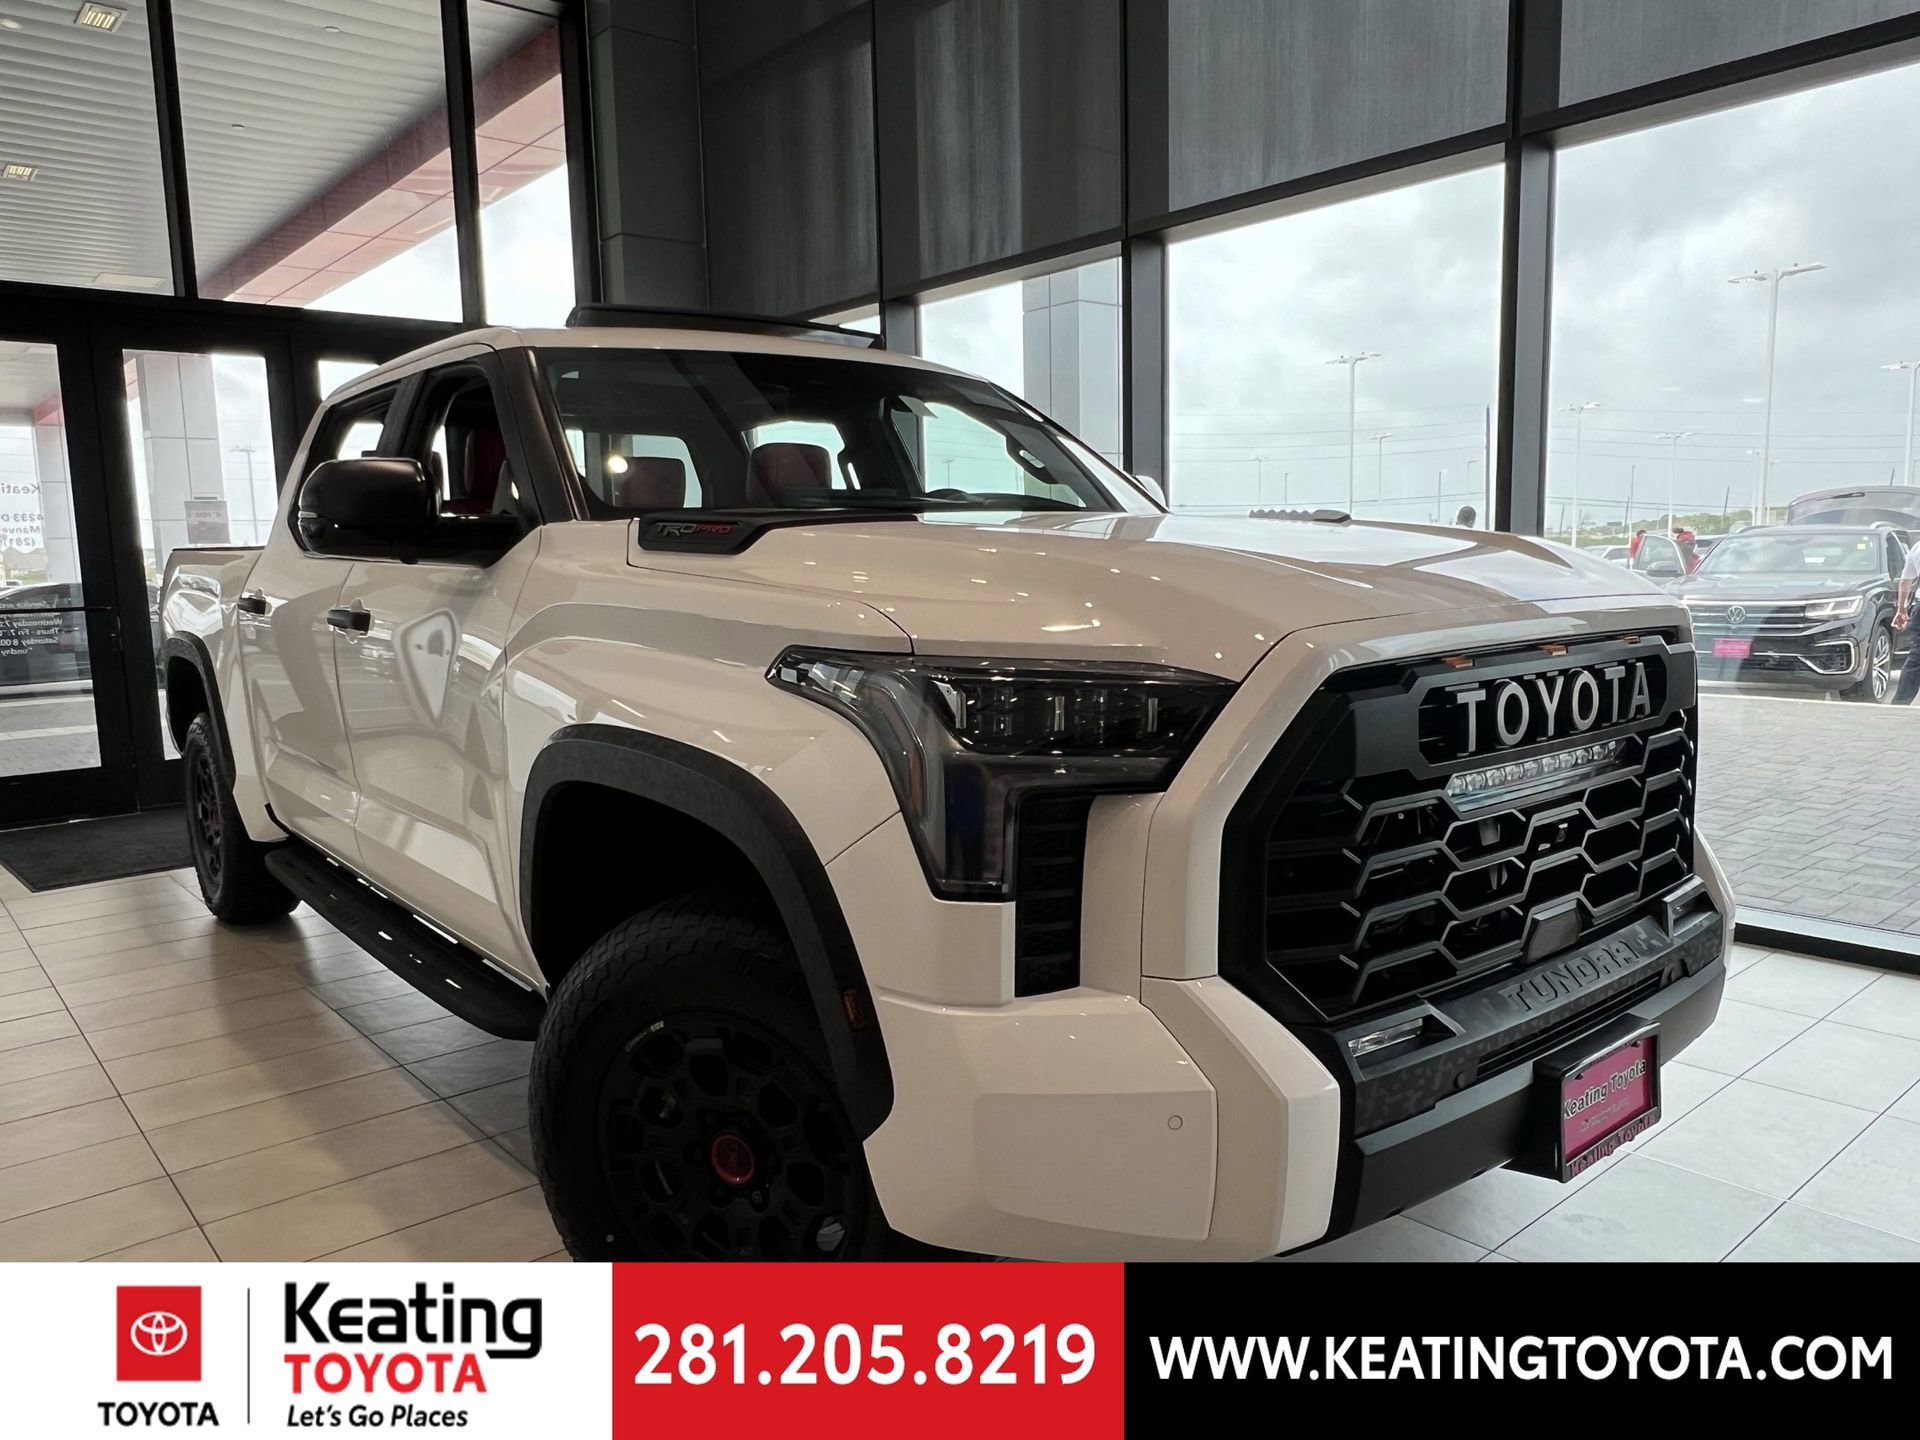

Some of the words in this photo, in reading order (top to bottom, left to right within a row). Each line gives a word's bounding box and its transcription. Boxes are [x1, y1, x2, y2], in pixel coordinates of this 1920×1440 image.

[695, 522, 733, 535] PRO
[1456, 661, 1651, 753] TOYOTA
[1501, 939, 1641, 1012] TUNDRA
[1562, 1082, 1608, 1119] Keating
[1609, 1058, 1647, 1093] Toyota
